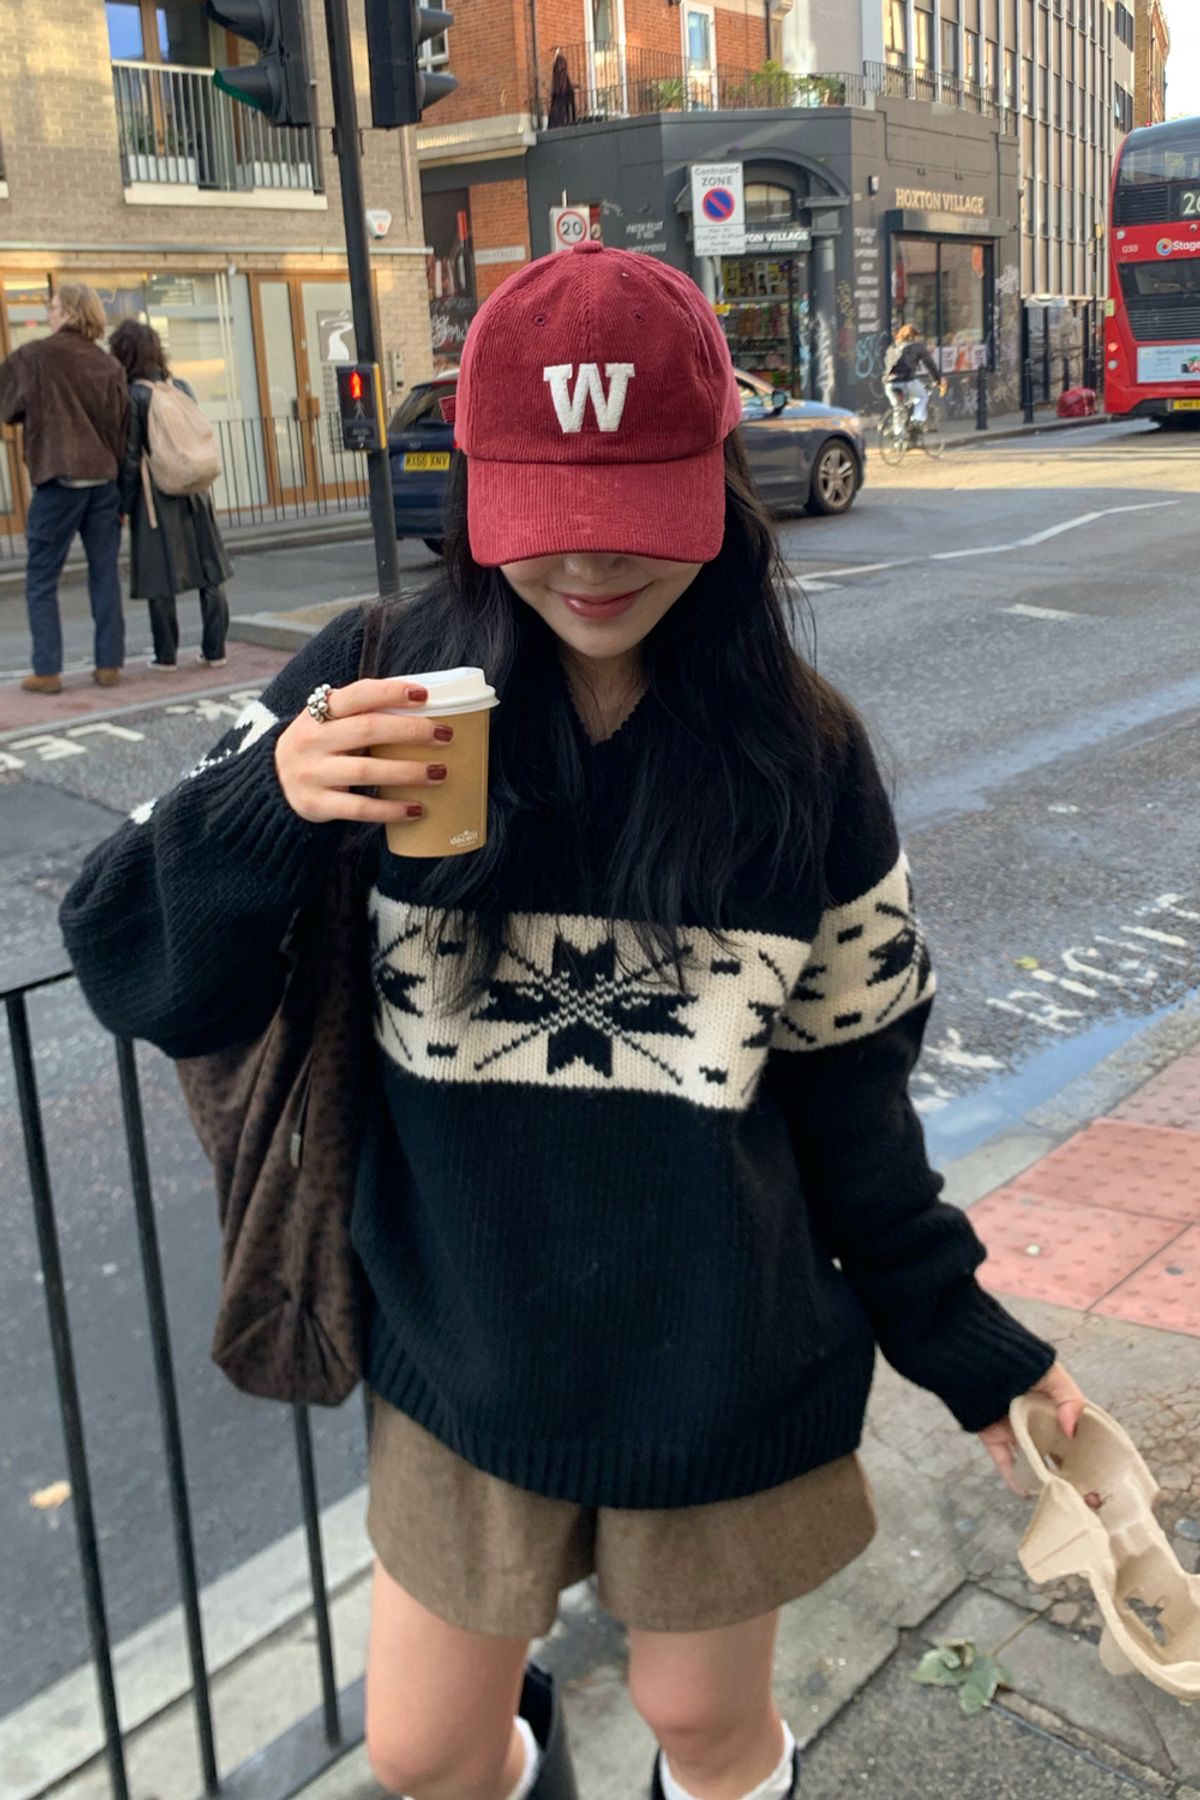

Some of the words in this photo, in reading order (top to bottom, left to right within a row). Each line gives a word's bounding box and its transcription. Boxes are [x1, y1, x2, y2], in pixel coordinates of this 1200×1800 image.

[694, 166, 740, 176] Controlled
[702, 176, 733, 186] ZONE
[895, 188, 941, 212] HOXTON
[942, 193, 985, 215] VILLAGE
[561, 221, 583, 236] 20
[765, 231, 808, 243] VILLAGE
[543, 362, 636, 434] W
